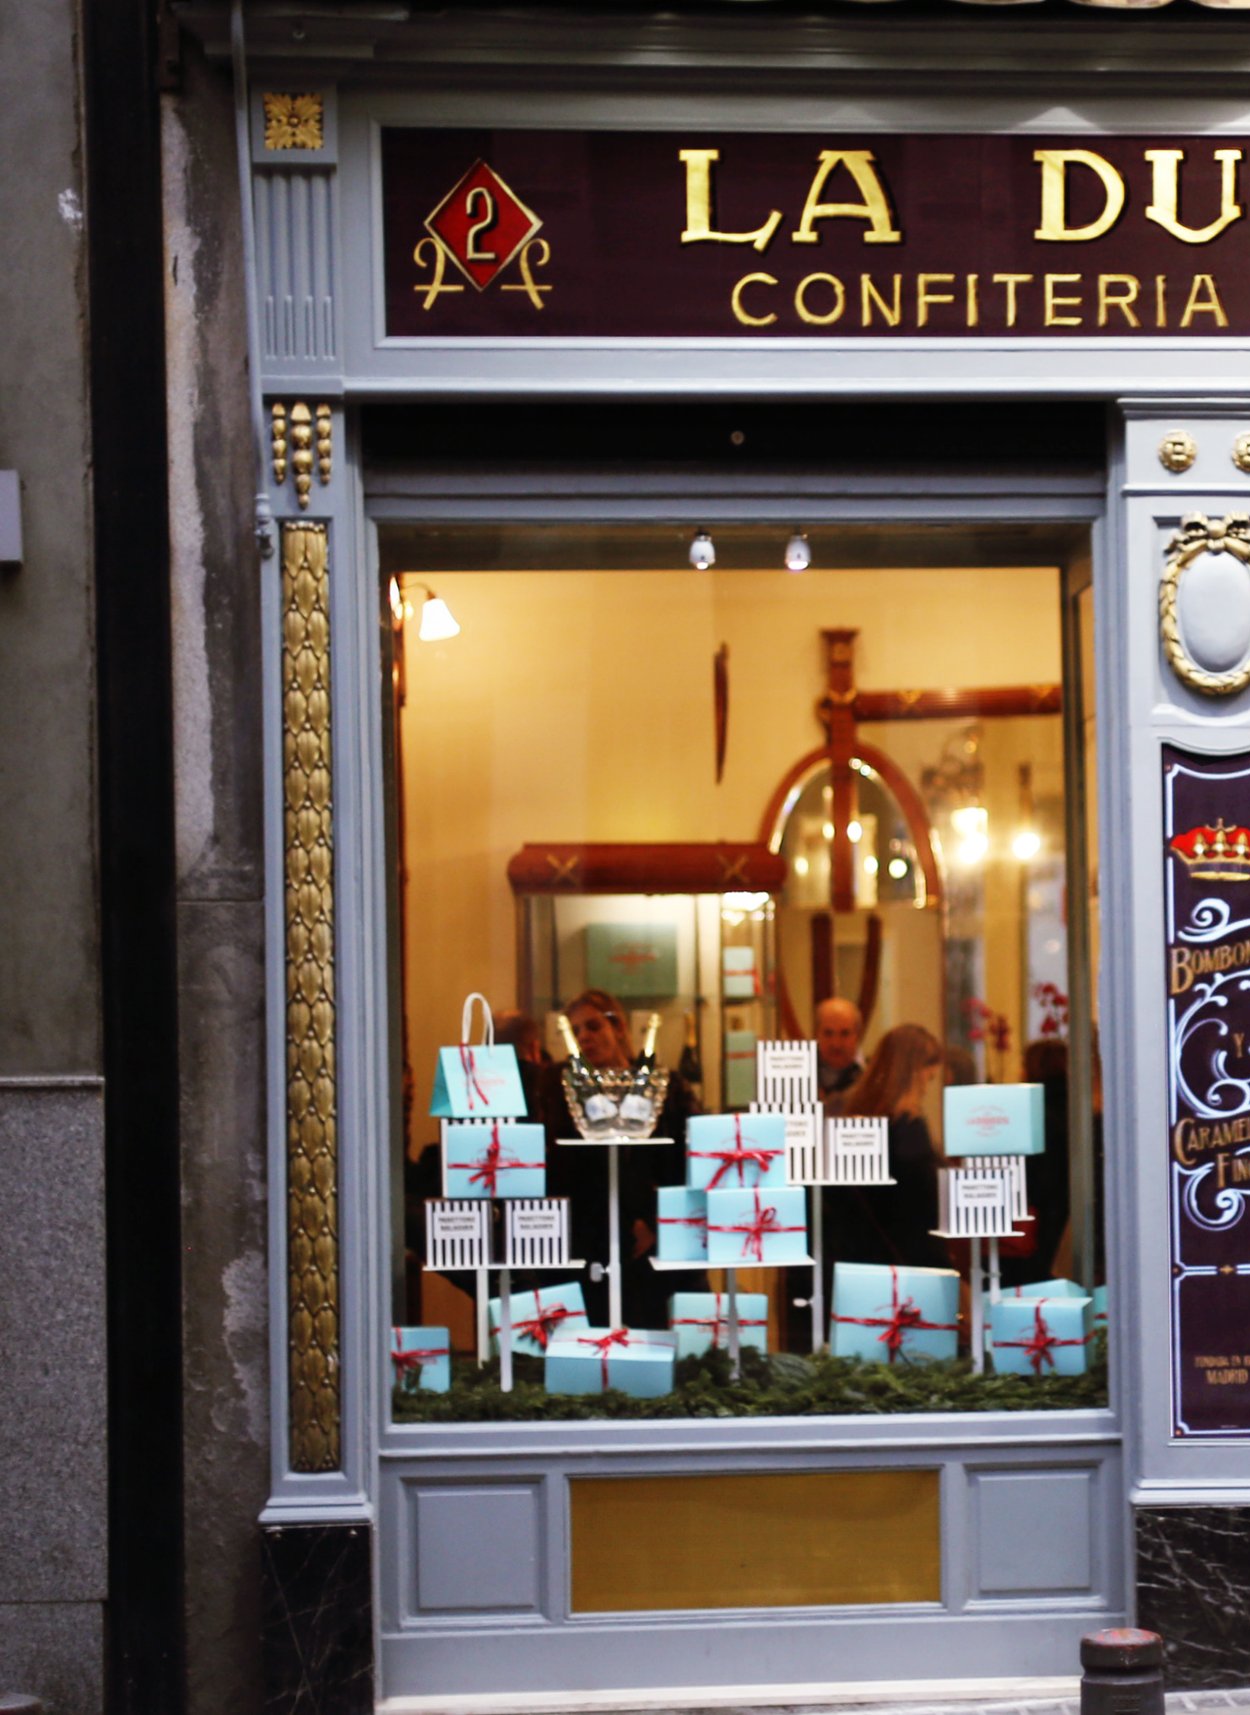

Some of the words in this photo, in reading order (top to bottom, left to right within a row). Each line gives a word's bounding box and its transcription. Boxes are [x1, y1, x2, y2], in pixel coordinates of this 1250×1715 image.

[465, 186, 497, 261] 2
[678, 148, 902, 253] LA
[730, 271, 1230, 329] CONFITERIA
[1232, 1032, 1245, 1059] Y
